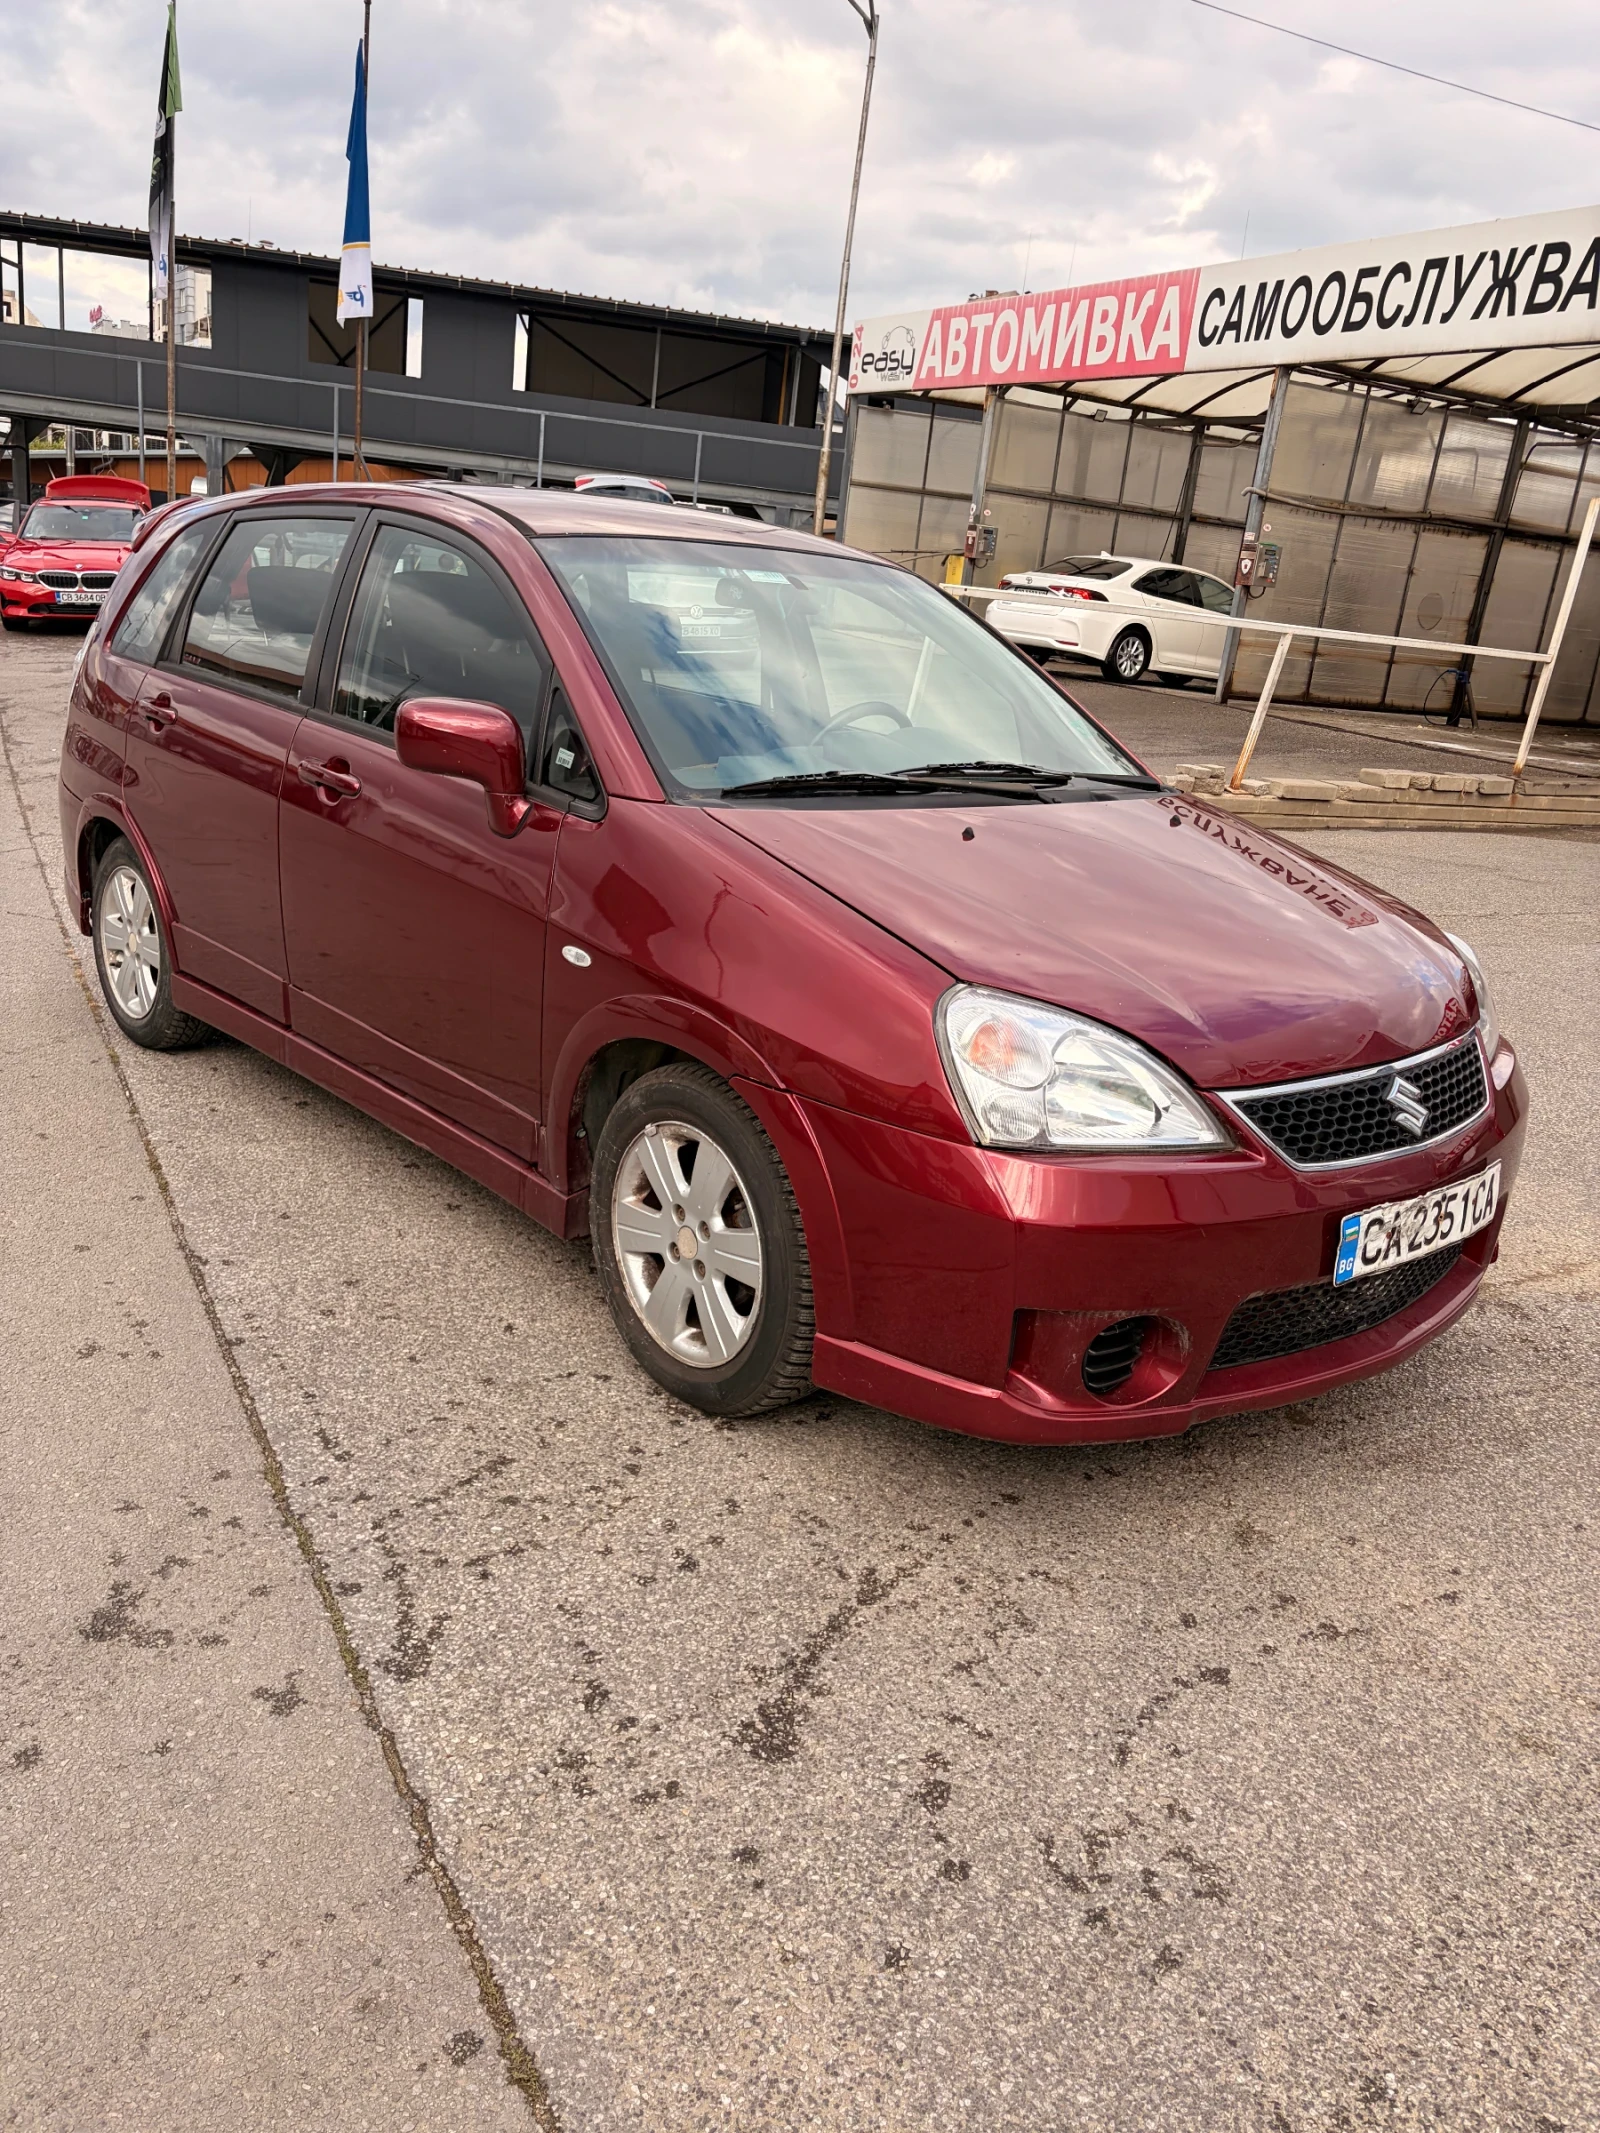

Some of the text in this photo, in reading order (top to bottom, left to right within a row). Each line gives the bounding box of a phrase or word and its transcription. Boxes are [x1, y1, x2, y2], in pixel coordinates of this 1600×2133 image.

[919, 236, 1600, 379] АВТОМИВКА САМООБСЛУЖВА
[849, 325, 864, 389] 0-24
[861, 348, 916, 376] easy
[74, 593, 94, 602] 3684
[1338, 1257, 1354, 1274] BG
